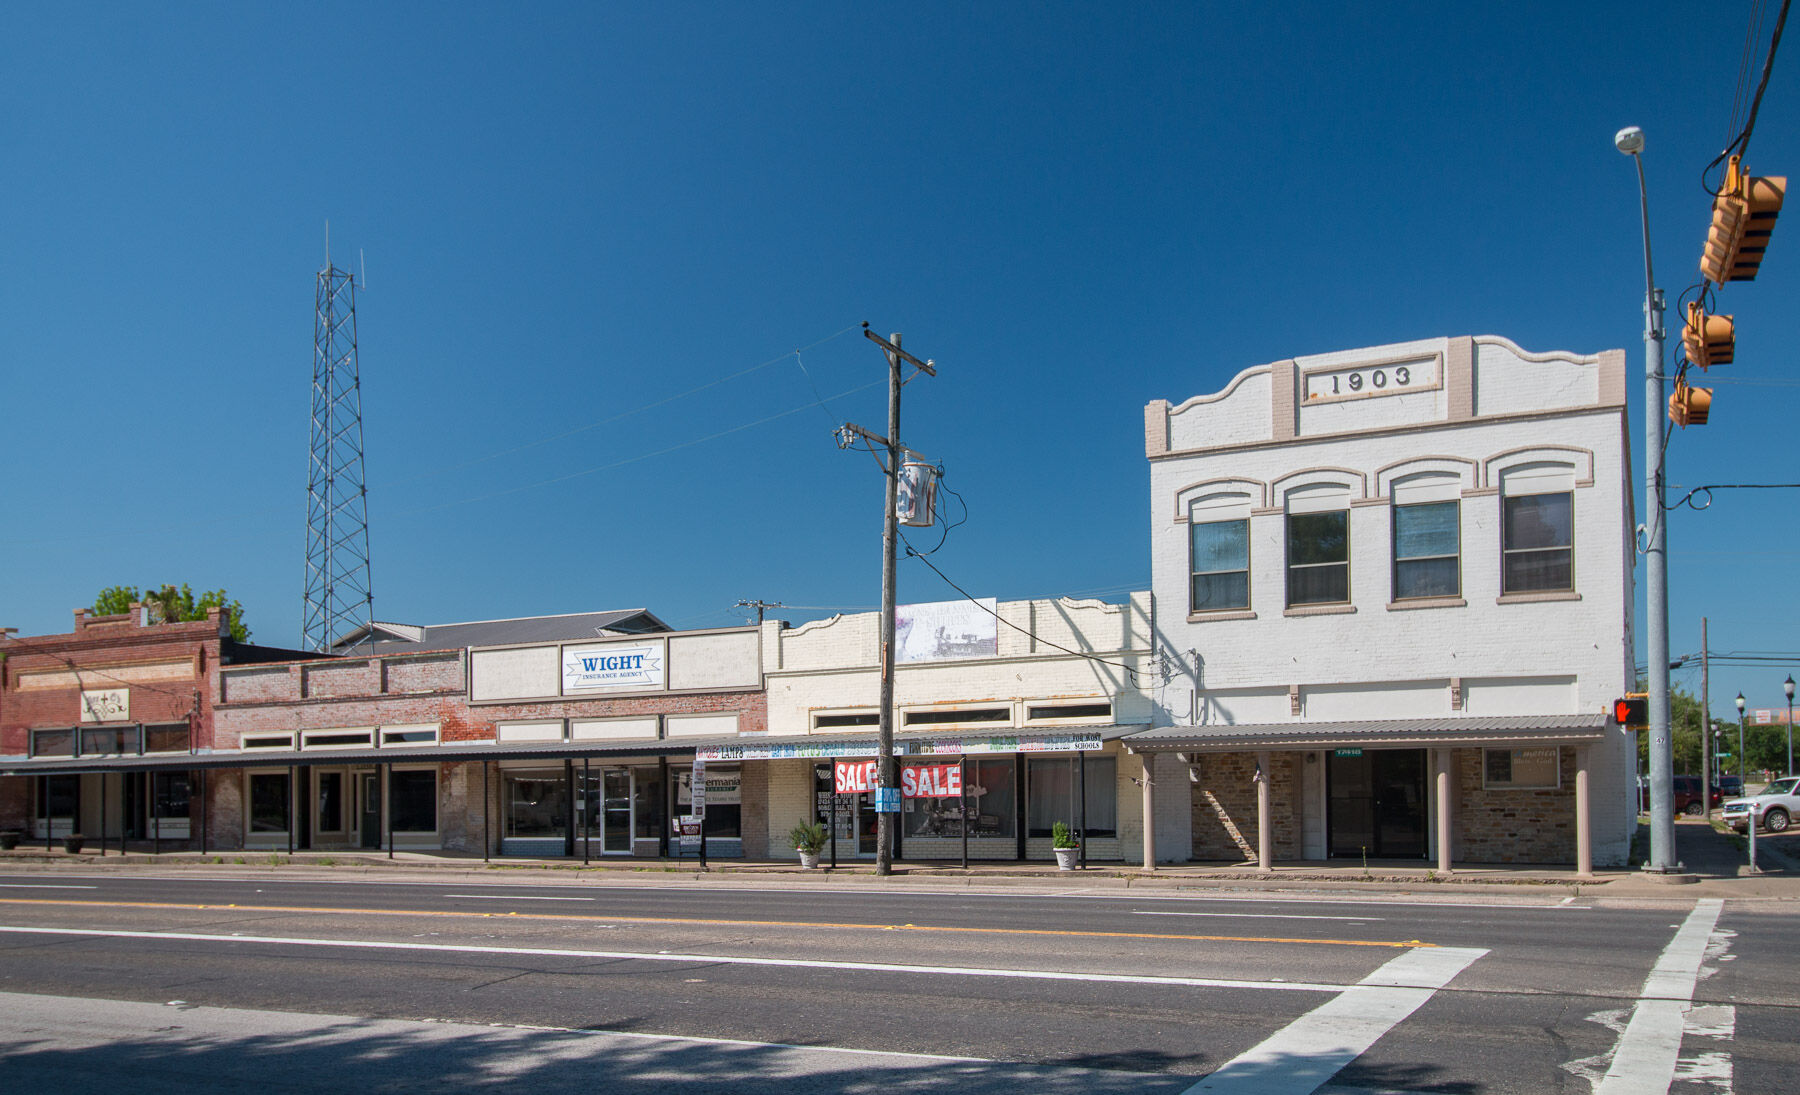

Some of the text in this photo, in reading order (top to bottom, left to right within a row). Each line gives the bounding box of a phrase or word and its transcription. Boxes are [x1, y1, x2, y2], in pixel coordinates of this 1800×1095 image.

[1332, 366, 1411, 394] 1903
[581, 654, 644, 672] WIGHT
[721, 744, 744, 759] LAMPS
[837, 763, 878, 791] SALE
[902, 767, 961, 796] SALE
